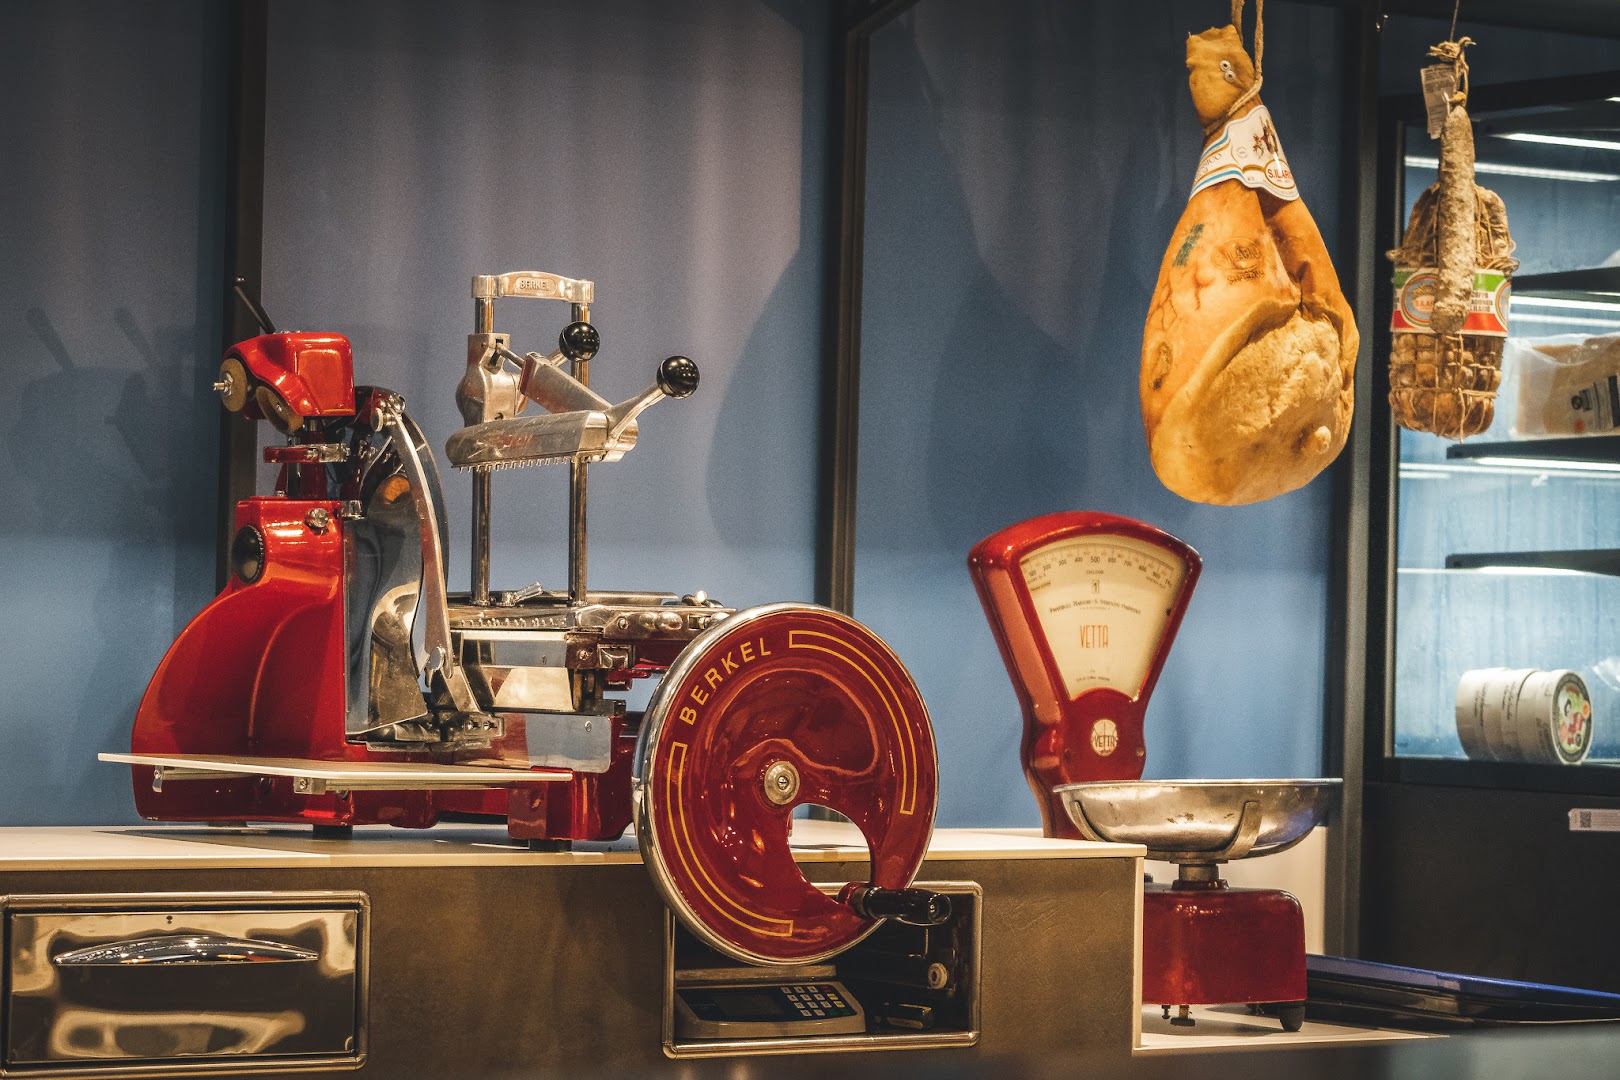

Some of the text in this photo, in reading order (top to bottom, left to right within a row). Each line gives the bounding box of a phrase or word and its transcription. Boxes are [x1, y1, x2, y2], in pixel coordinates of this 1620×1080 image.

[520, 280, 551, 291] BERKEL
[1079, 625, 1109, 649] VETTA
[679, 637, 772, 725] BERKEL
